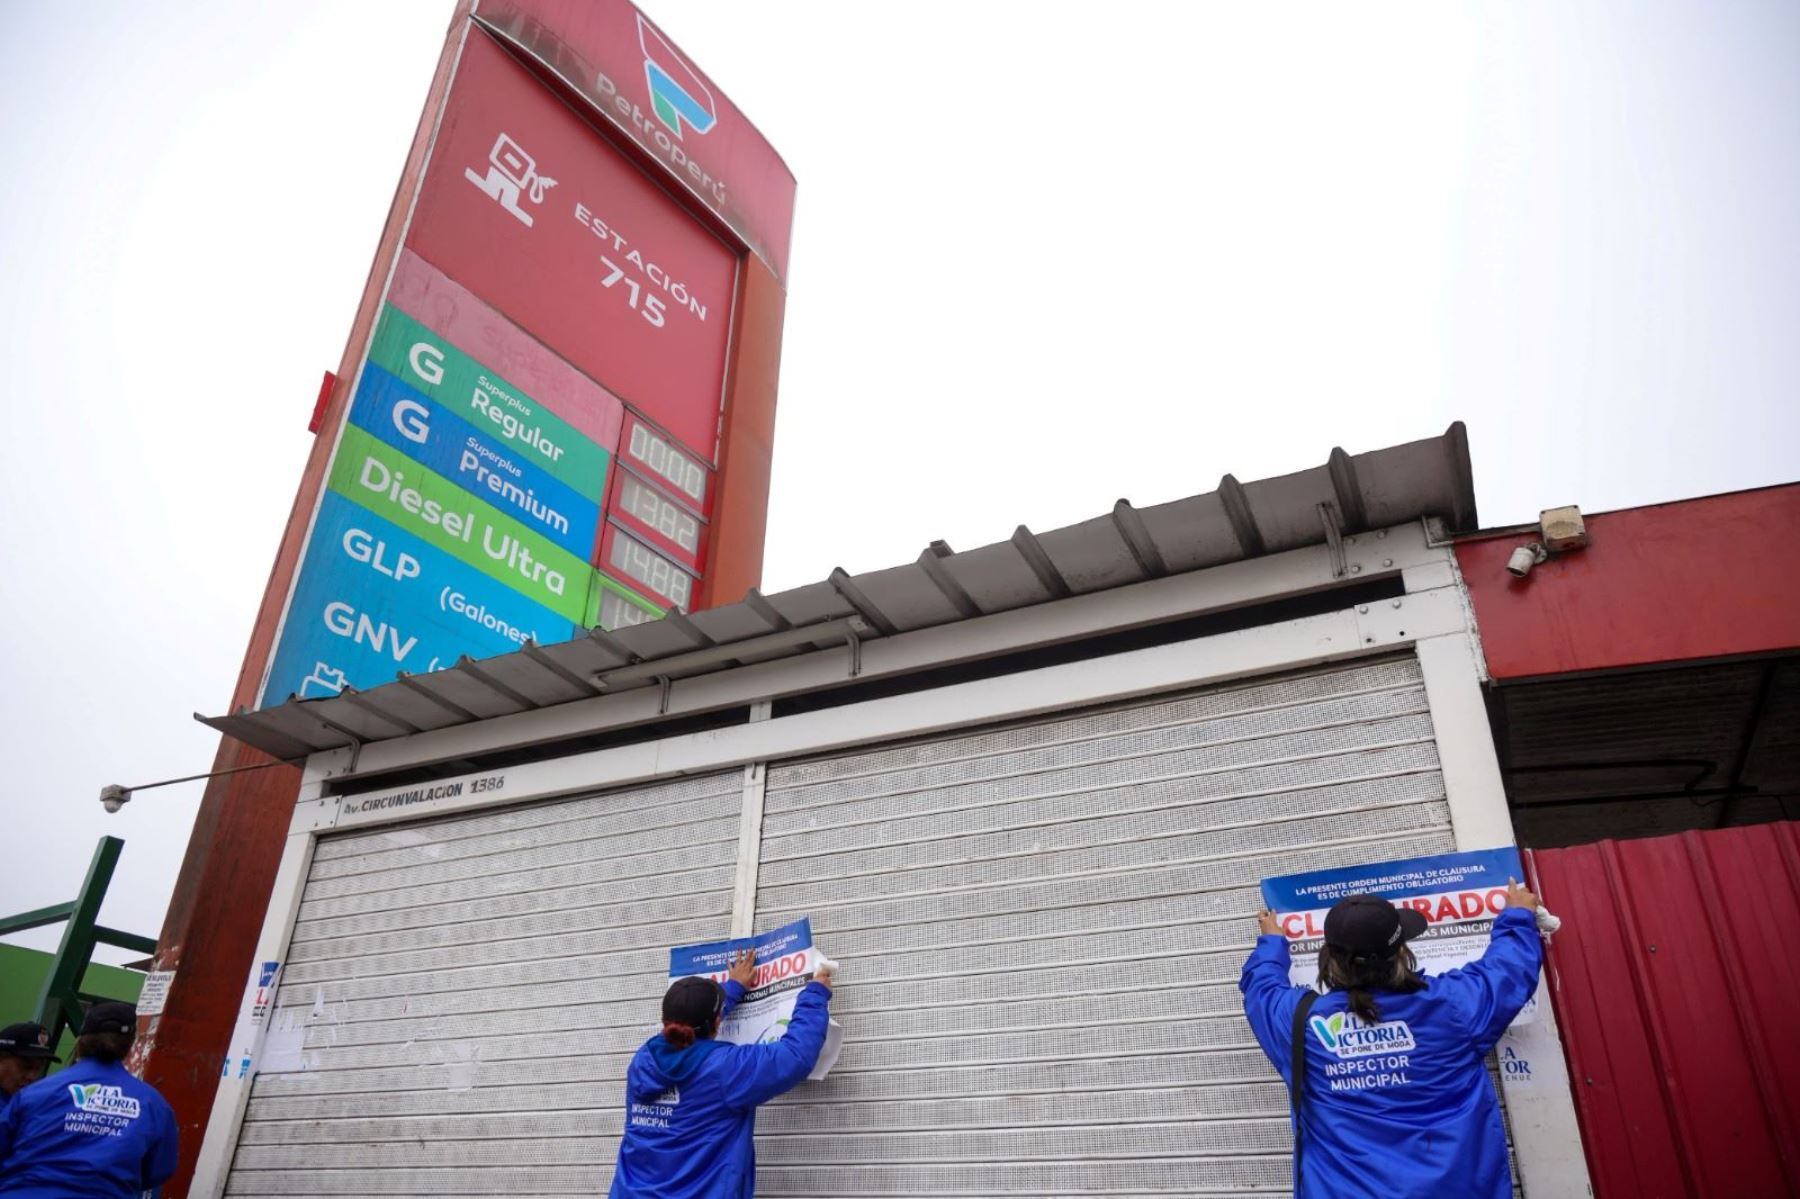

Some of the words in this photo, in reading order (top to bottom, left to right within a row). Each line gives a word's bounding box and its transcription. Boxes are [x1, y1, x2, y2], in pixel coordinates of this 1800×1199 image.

[596, 72, 726, 206] Petroperú
[574, 203, 707, 321] ESTACIÓN
[600, 256, 666, 328] 715
[409, 342, 444, 386] G
[478, 375, 532, 416] Superplus
[392, 399, 430, 444] G
[471, 387, 564, 462] Regular
[466, 436, 523, 478] Superplus
[459, 450, 569, 535] Premium
[359, 456, 474, 543] Diesel
[483, 525, 567, 596] Ultra
[342, 528, 421, 582] GLP
[324, 601, 418, 662] GNV
[469, 775, 505, 794] 1386
[1295, 888, 1306, 896] LA
[1307, 882, 1348, 894] PRESENTE
[1348, 878, 1378, 888] ORDEN
[1379, 873, 1425, 885] MUNICIPAL
[1425, 869, 1438, 878] DE
[1438, 864, 1486, 877] CLAUSURA
[1317, 892, 1329, 901] ES
[1328, 891, 1340, 900] DE
[1341, 880, 1407, 897] CUMPLIMIENTO
[1405, 875, 1464, 889] OBLIGATORIO
[1282, 888, 1511, 939] CLRADO
[1325, 1055, 1410, 1077] INSPECTOR
[1331, 1072, 1412, 1091] MUNICIPAL
[64, 1122, 123, 1137] MUNICIPAL
[65, 1112, 130, 1128] INSPECTOR
